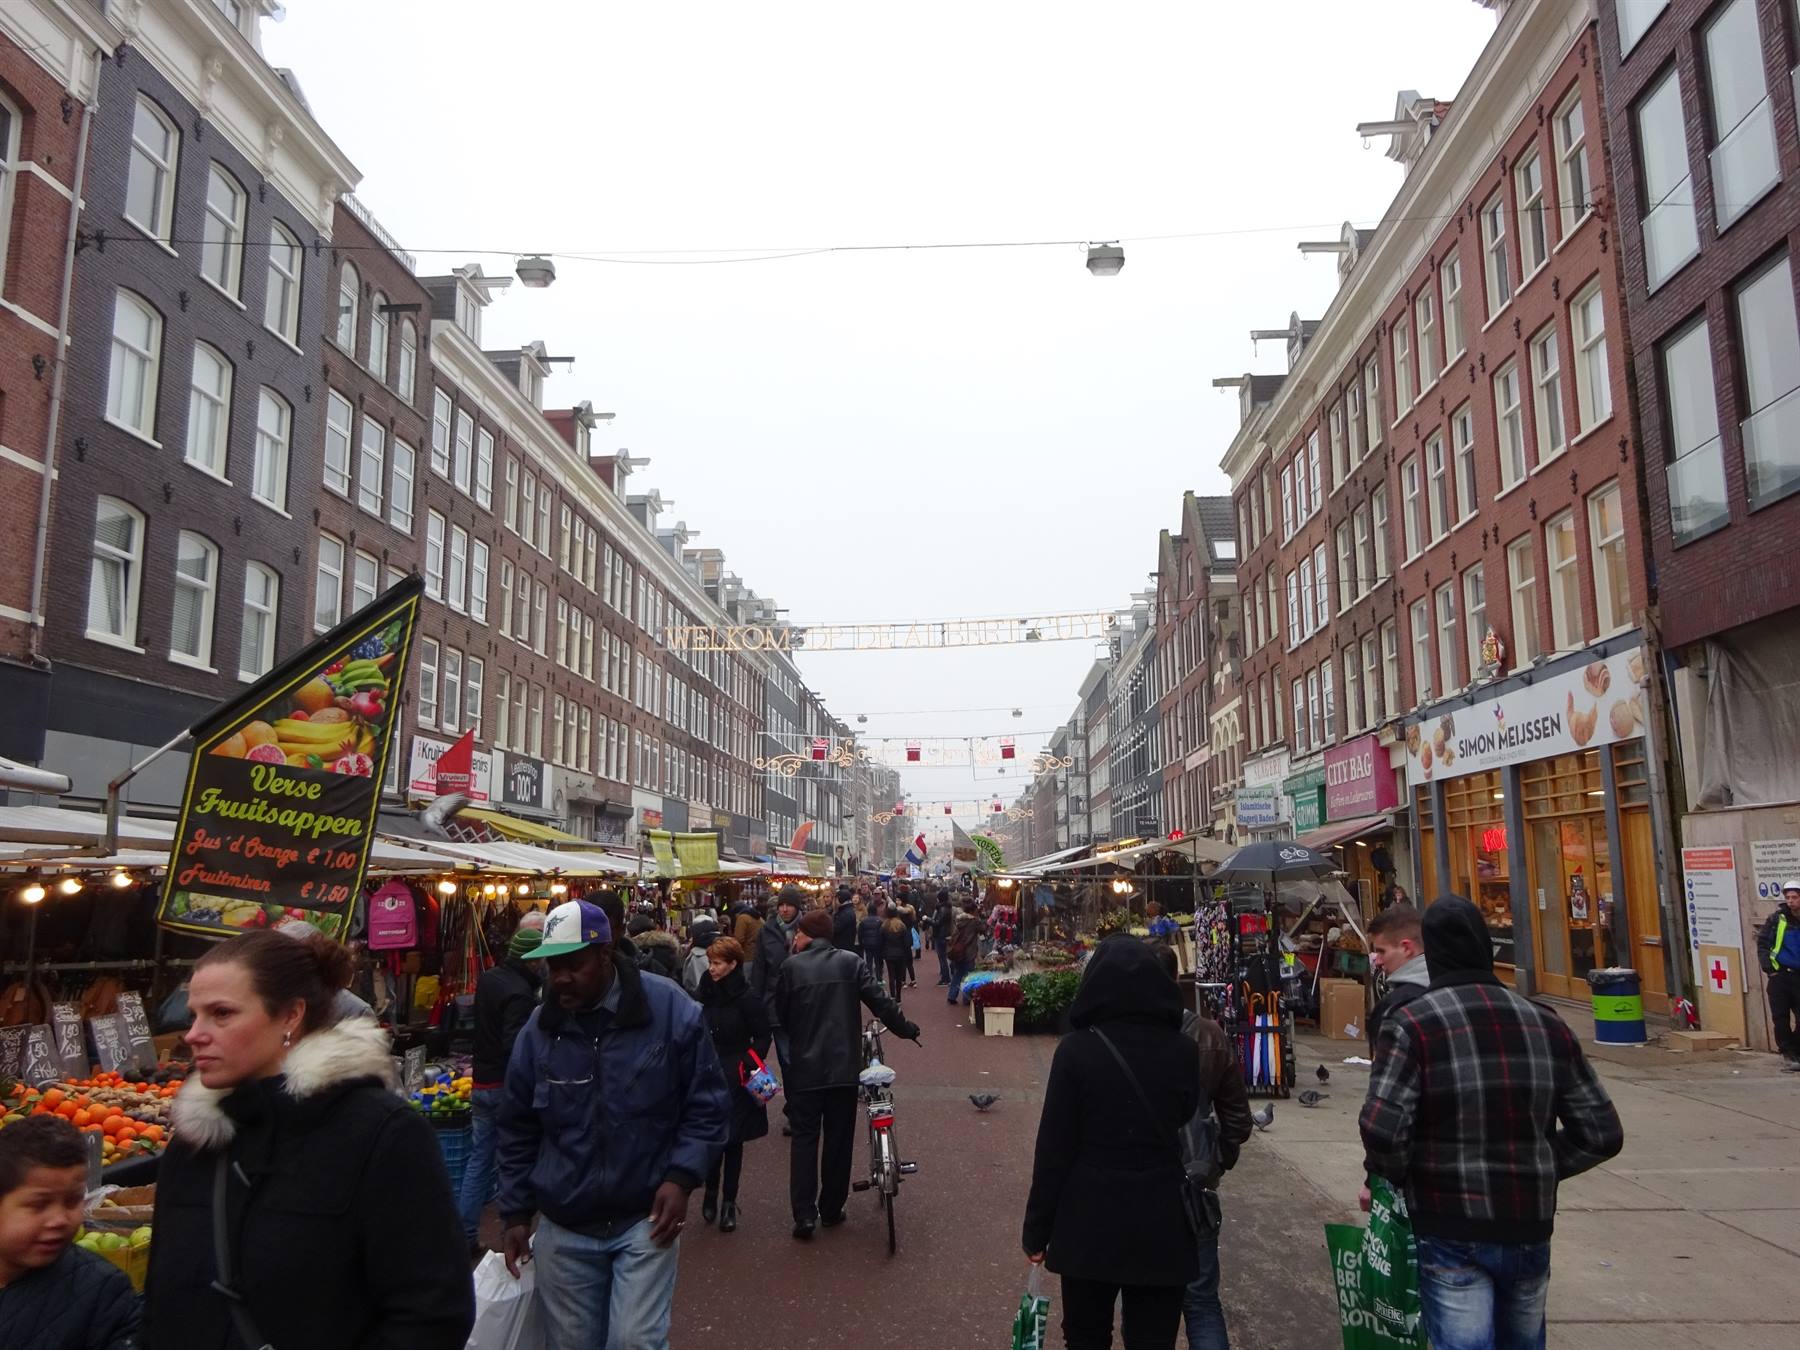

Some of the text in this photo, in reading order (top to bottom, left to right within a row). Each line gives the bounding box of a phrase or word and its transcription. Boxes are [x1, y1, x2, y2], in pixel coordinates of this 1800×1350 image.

[665, 625, 790, 651] WELKOM
[804, 625, 843, 650] OP
[1458, 731, 1495, 759] SIMON
[1498, 713, 1561, 750] MEIJSSEN
[251, 764, 322, 800] Verse
[1327, 760, 1349, 787] CITY
[1349, 752, 1372, 781] BAG
[195, 787, 363, 839] Fruitsappen
[1237, 813, 1258, 825] Slagerij
[1239, 801, 1272, 812] Islamitische
[244, 836, 299, 868] Orange
[323, 850, 357, 869] 1,00
[315, 884, 350, 903] 1,50
